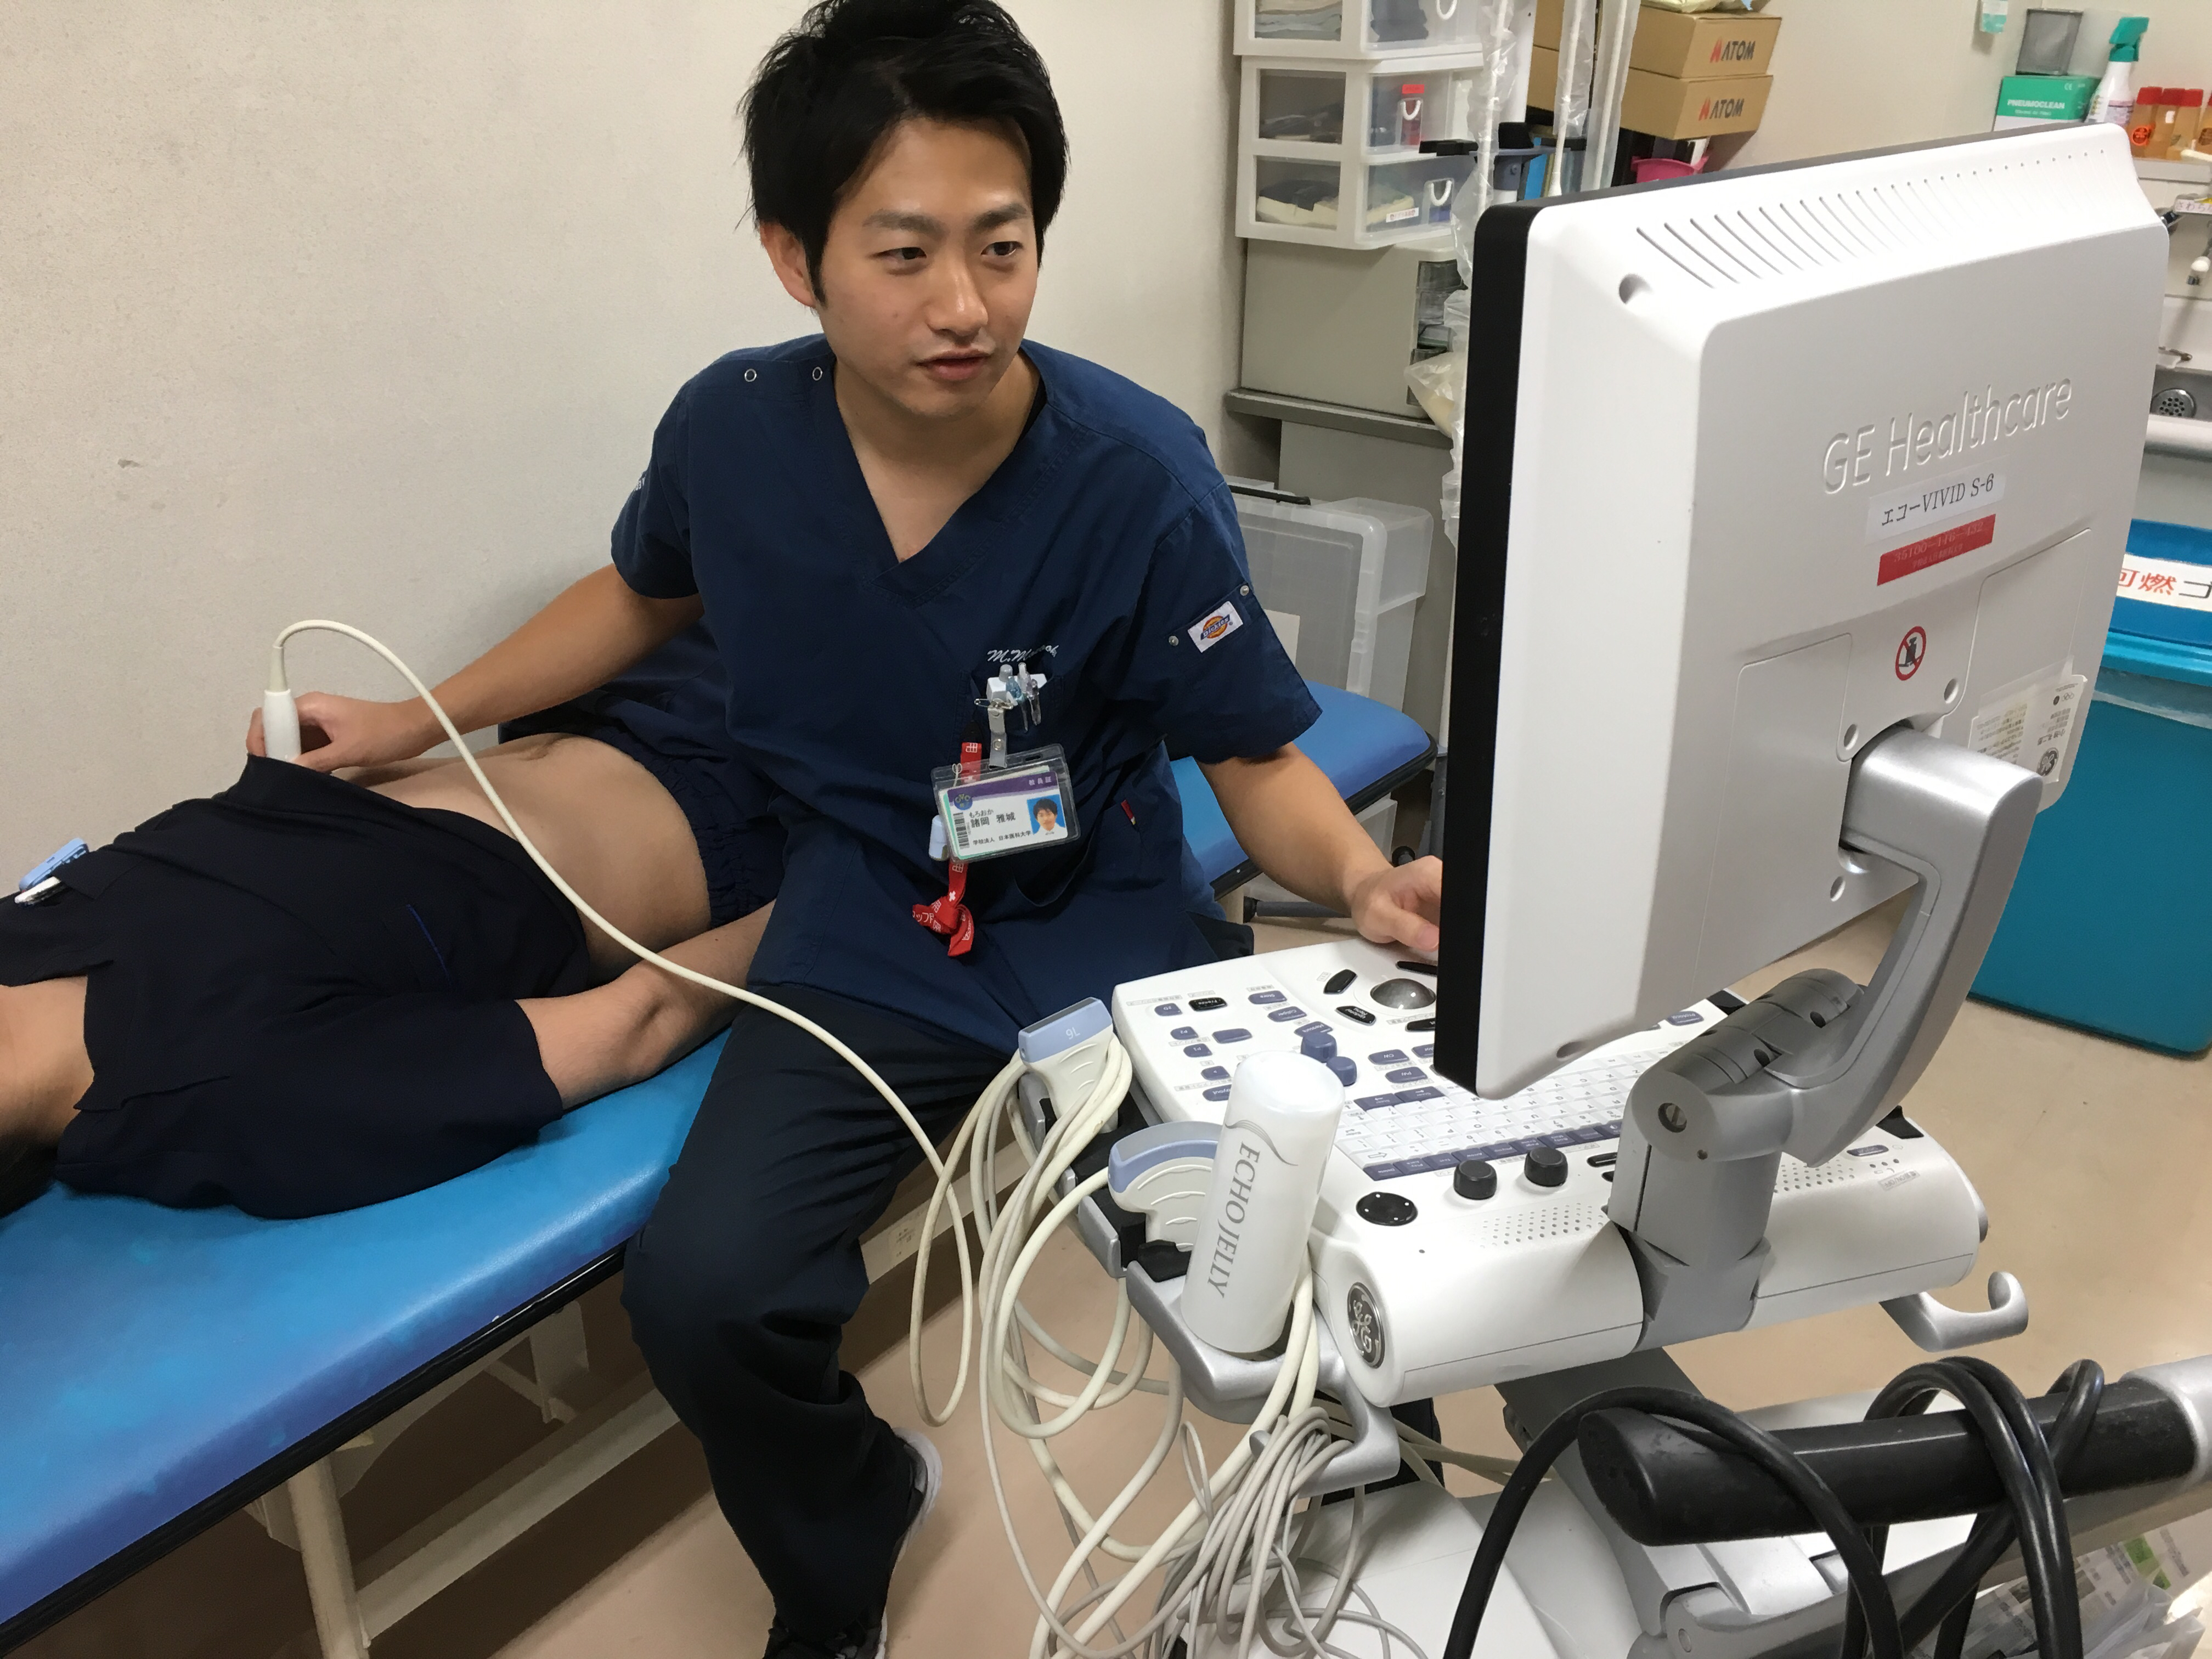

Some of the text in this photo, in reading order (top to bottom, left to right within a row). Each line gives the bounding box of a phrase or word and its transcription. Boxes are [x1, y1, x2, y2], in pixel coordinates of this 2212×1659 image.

[1721, 40, 1756, 61] ATOM
[1709, 98, 1745, 119] ATOM
[2007, 99, 2065, 109] PNEUMOCLEAN
[1822, 378, 2072, 494] GE Healthcare
[1971, 473, 1995, 497] S-6
[969, 809, 994, 818] もろおか
[1066, 1026, 1080, 1040] 9L
[1207, 1141, 1261, 1299] ECHO JELLY
